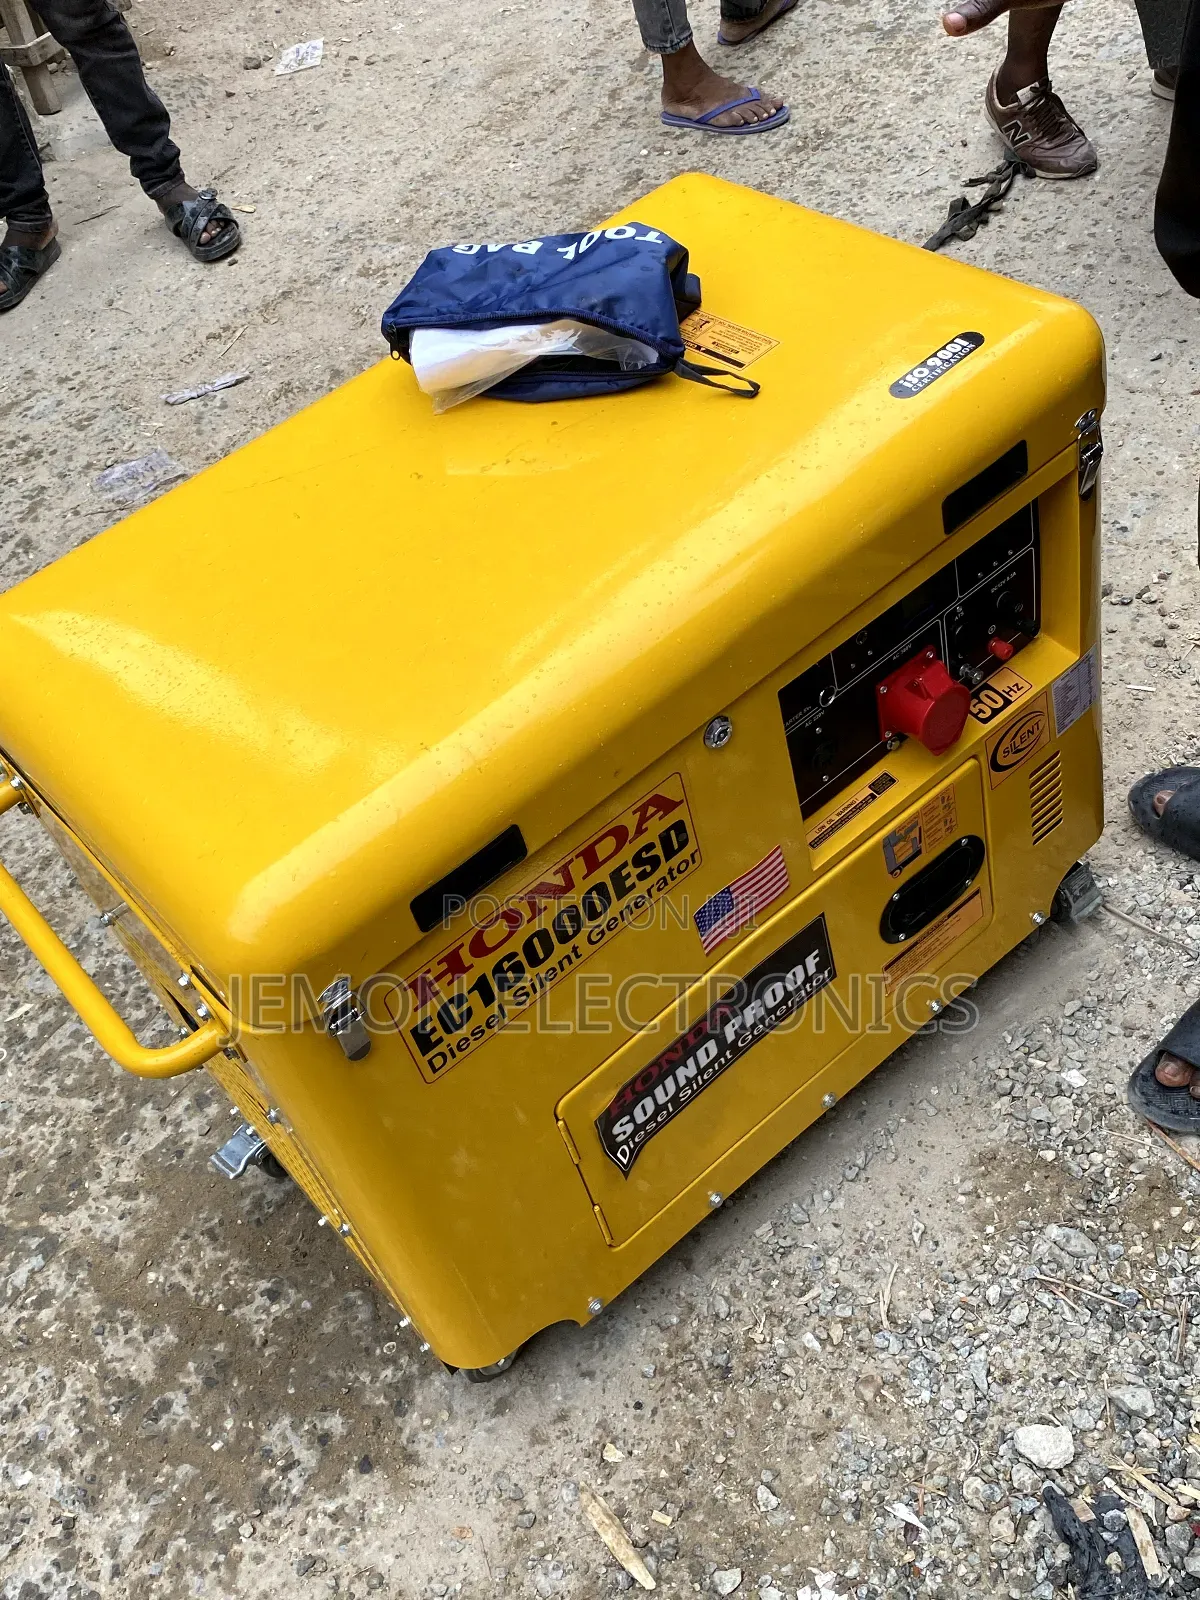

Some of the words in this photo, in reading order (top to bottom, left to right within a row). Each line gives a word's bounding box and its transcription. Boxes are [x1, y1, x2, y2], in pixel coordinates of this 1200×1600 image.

[911, 343, 976, 392] CERTIFICATION
[927, 338, 969, 367] 9001
[970, 689, 1004, 719] 50
[1002, 682, 1024, 698] Hz
[403, 793, 684, 1012] HONDA
[814, 824, 827, 835] LOW
[410, 819, 689, 1057] EC16000ESD
[427, 1003, 509, 1074] Diesel
[512, 944, 583, 1008] Silent
[587, 848, 699, 945] Generator
[608, 1003, 737, 1118] HONDA
[611, 1038, 718, 1144] SOUND
[723, 949, 820, 1044] PROOF
[617, 1102, 674, 1165] Diesel
[679, 1049, 733, 1103] Silent
[737, 967, 831, 1048] Generator
